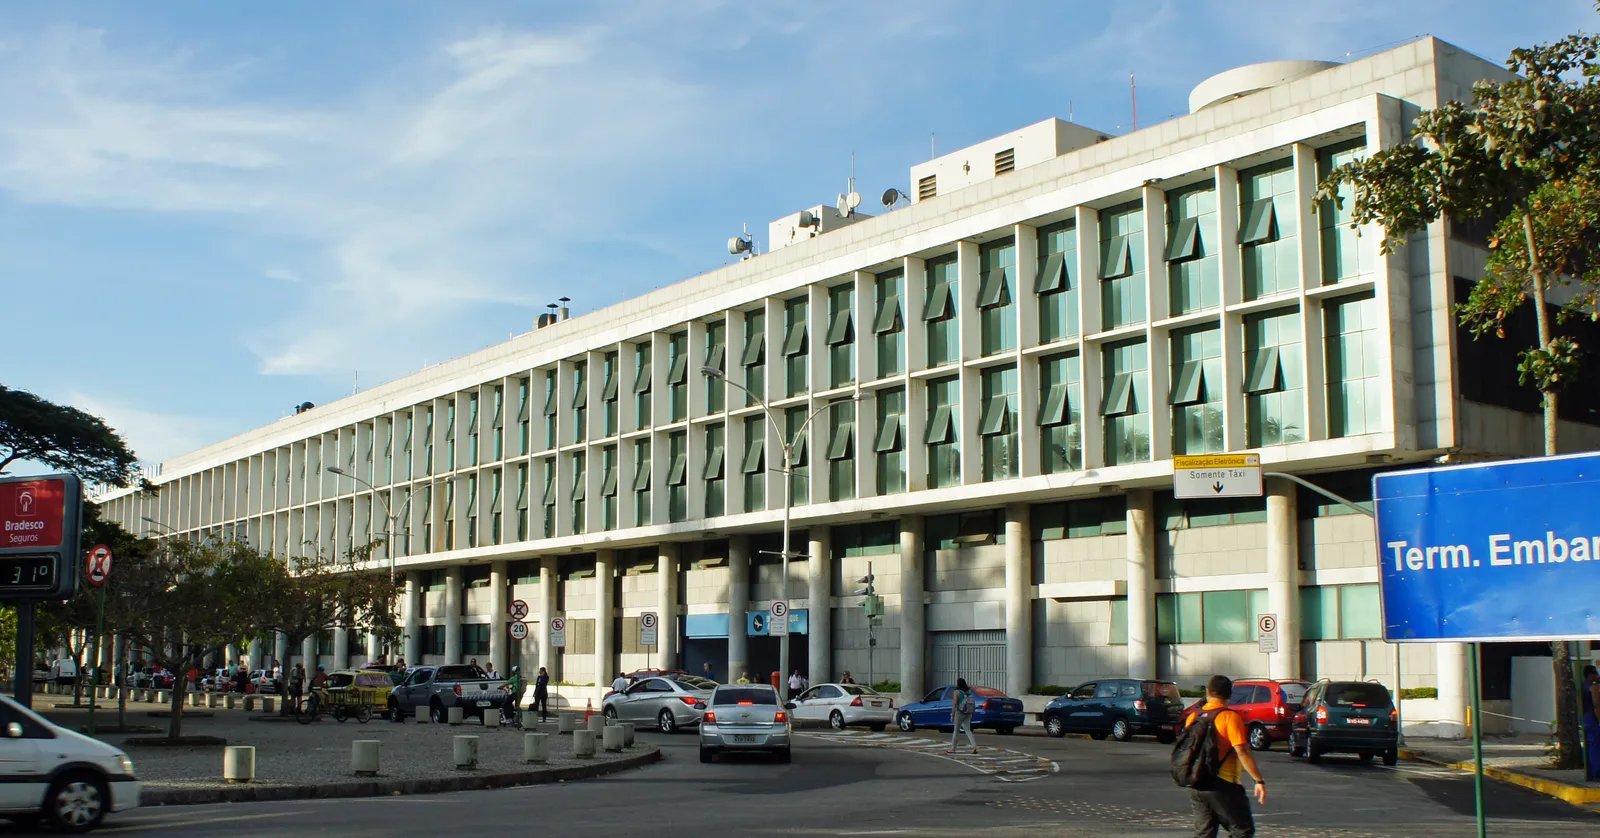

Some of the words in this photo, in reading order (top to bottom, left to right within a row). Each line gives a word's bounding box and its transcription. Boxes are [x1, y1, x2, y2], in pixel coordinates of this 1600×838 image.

[1176, 458, 1213, 467] Fiscalização
[1214, 457, 1245, 465] Eletrônica
[1189, 470, 1225, 479] Somente
[1228, 469, 1246, 478] Táxi
[5, 520, 44, 531] Bradesco
[9, 533, 39, 544] Seguros
[1387, 541, 1480, 571] Term.
[776, 605, 782, 613] E
[1265, 620, 1271, 628] E
